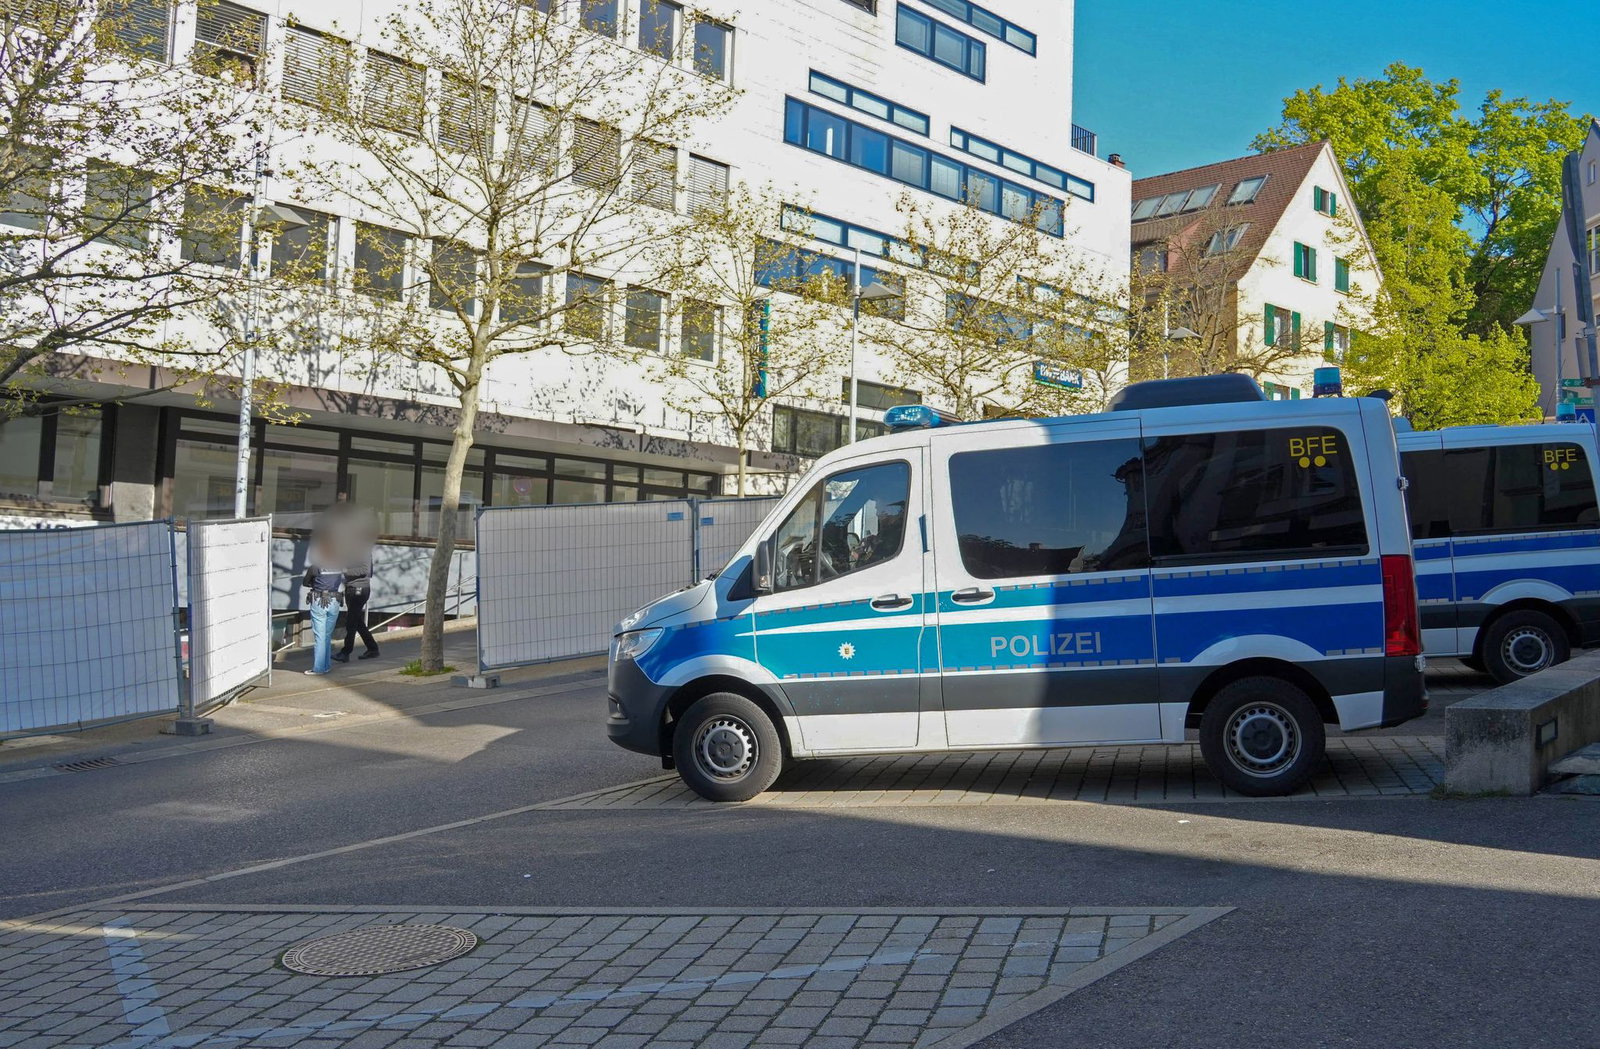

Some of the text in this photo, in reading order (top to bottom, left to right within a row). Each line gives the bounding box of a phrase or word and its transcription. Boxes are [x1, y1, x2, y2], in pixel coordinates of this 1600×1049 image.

[1289, 435, 1338, 457] BFE
[1544, 448, 1578, 463] BFE
[990, 631, 1102, 658] POLIZEI
